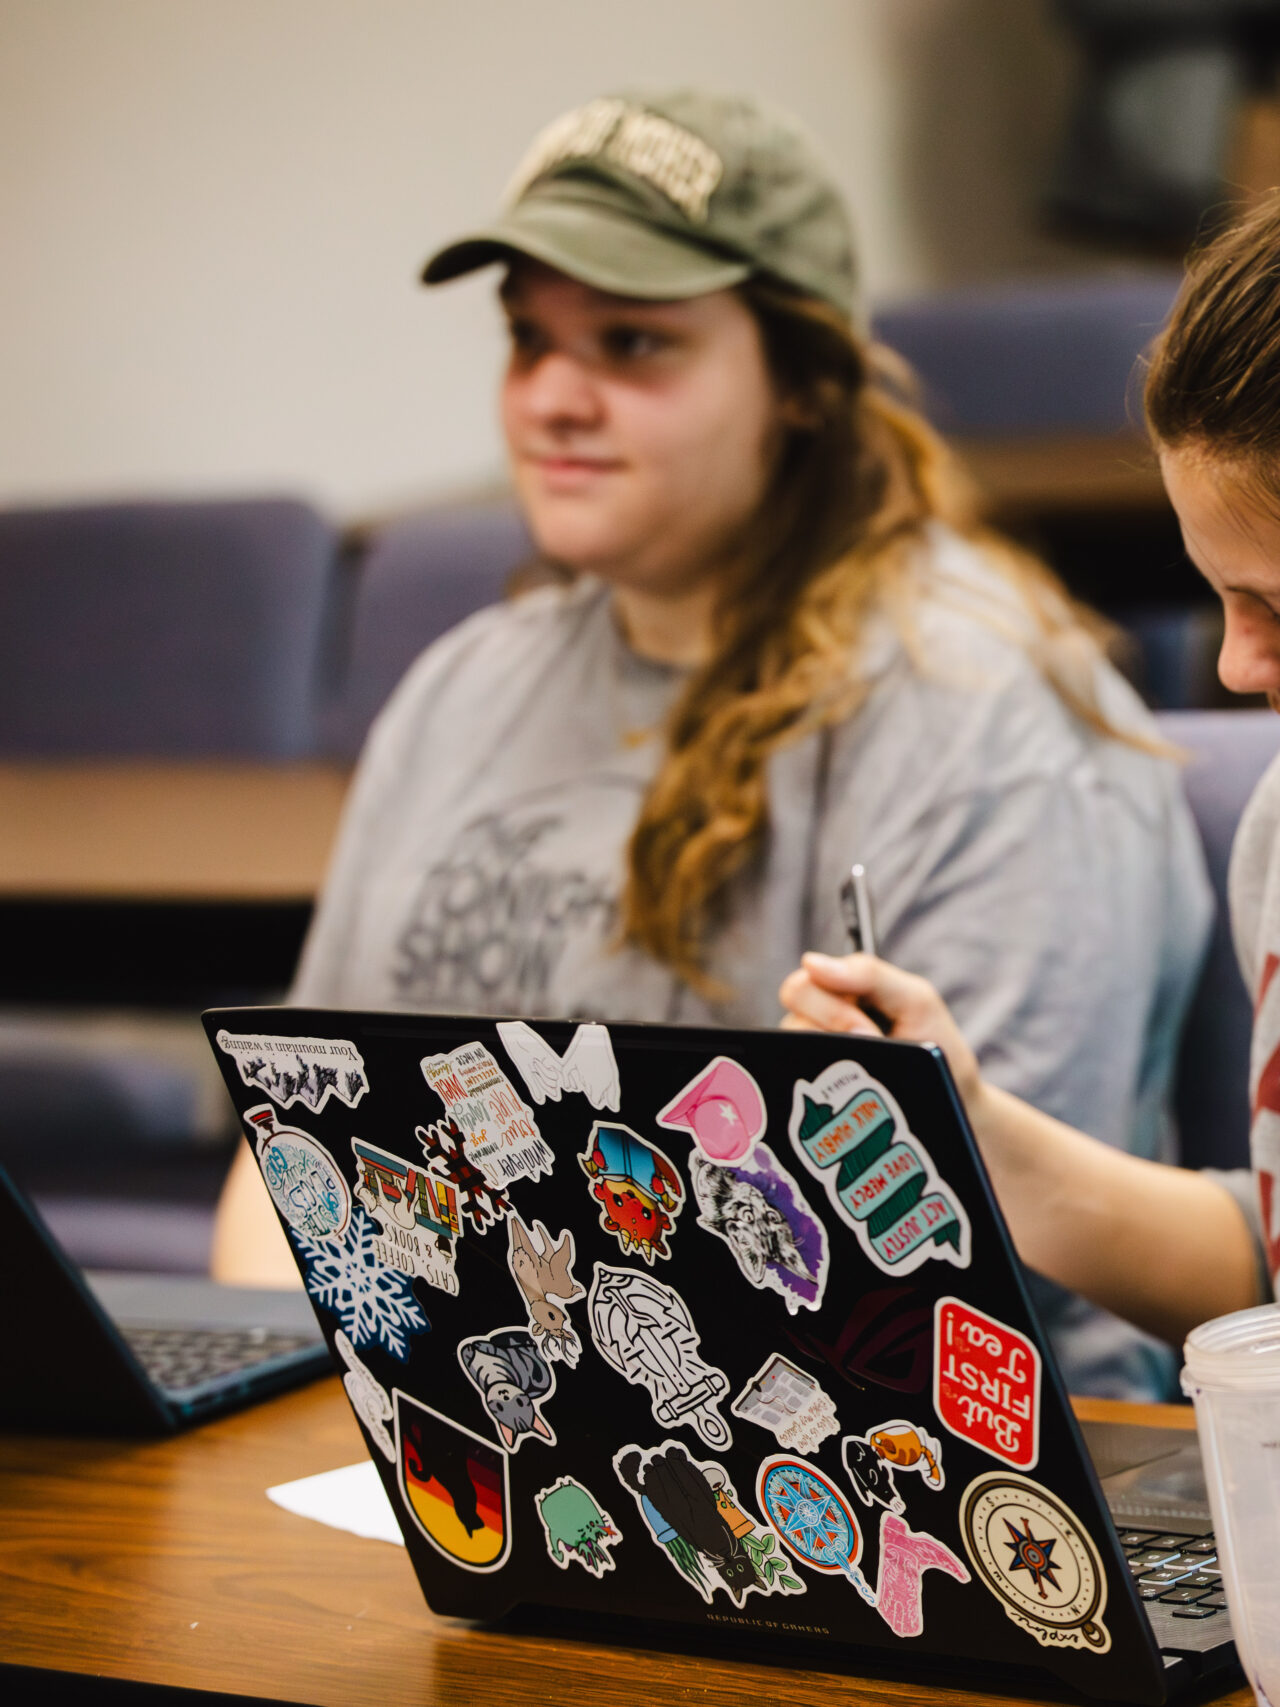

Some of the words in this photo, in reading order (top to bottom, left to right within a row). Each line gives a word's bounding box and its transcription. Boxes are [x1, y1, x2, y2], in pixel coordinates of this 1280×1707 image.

[221, 1036, 262, 1054] waiting
[264, 1042, 274, 1055] is
[275, 1043, 326, 1055] mountain
[330, 1046, 357, 1060] Your
[811, 1120, 852, 1162] HUMBLY
[883, 1152, 917, 1178] LOVE
[849, 1173, 889, 1211] MERCY
[921, 1198, 947, 1227] ACT
[385, 1223, 420, 1256] BOOKS
[424, 1243, 433, 1258] &
[882, 1215, 923, 1259] JUSTLY
[374, 1240, 415, 1275] COFFEE
[942, 1354, 1031, 1420] FIRST
[958, 1396, 1021, 1453] But
[707, 1613, 763, 1627] REPUBLIC
[782, 1623, 830, 1634] GAMERS
[1011, 1612, 1078, 1643] explore
